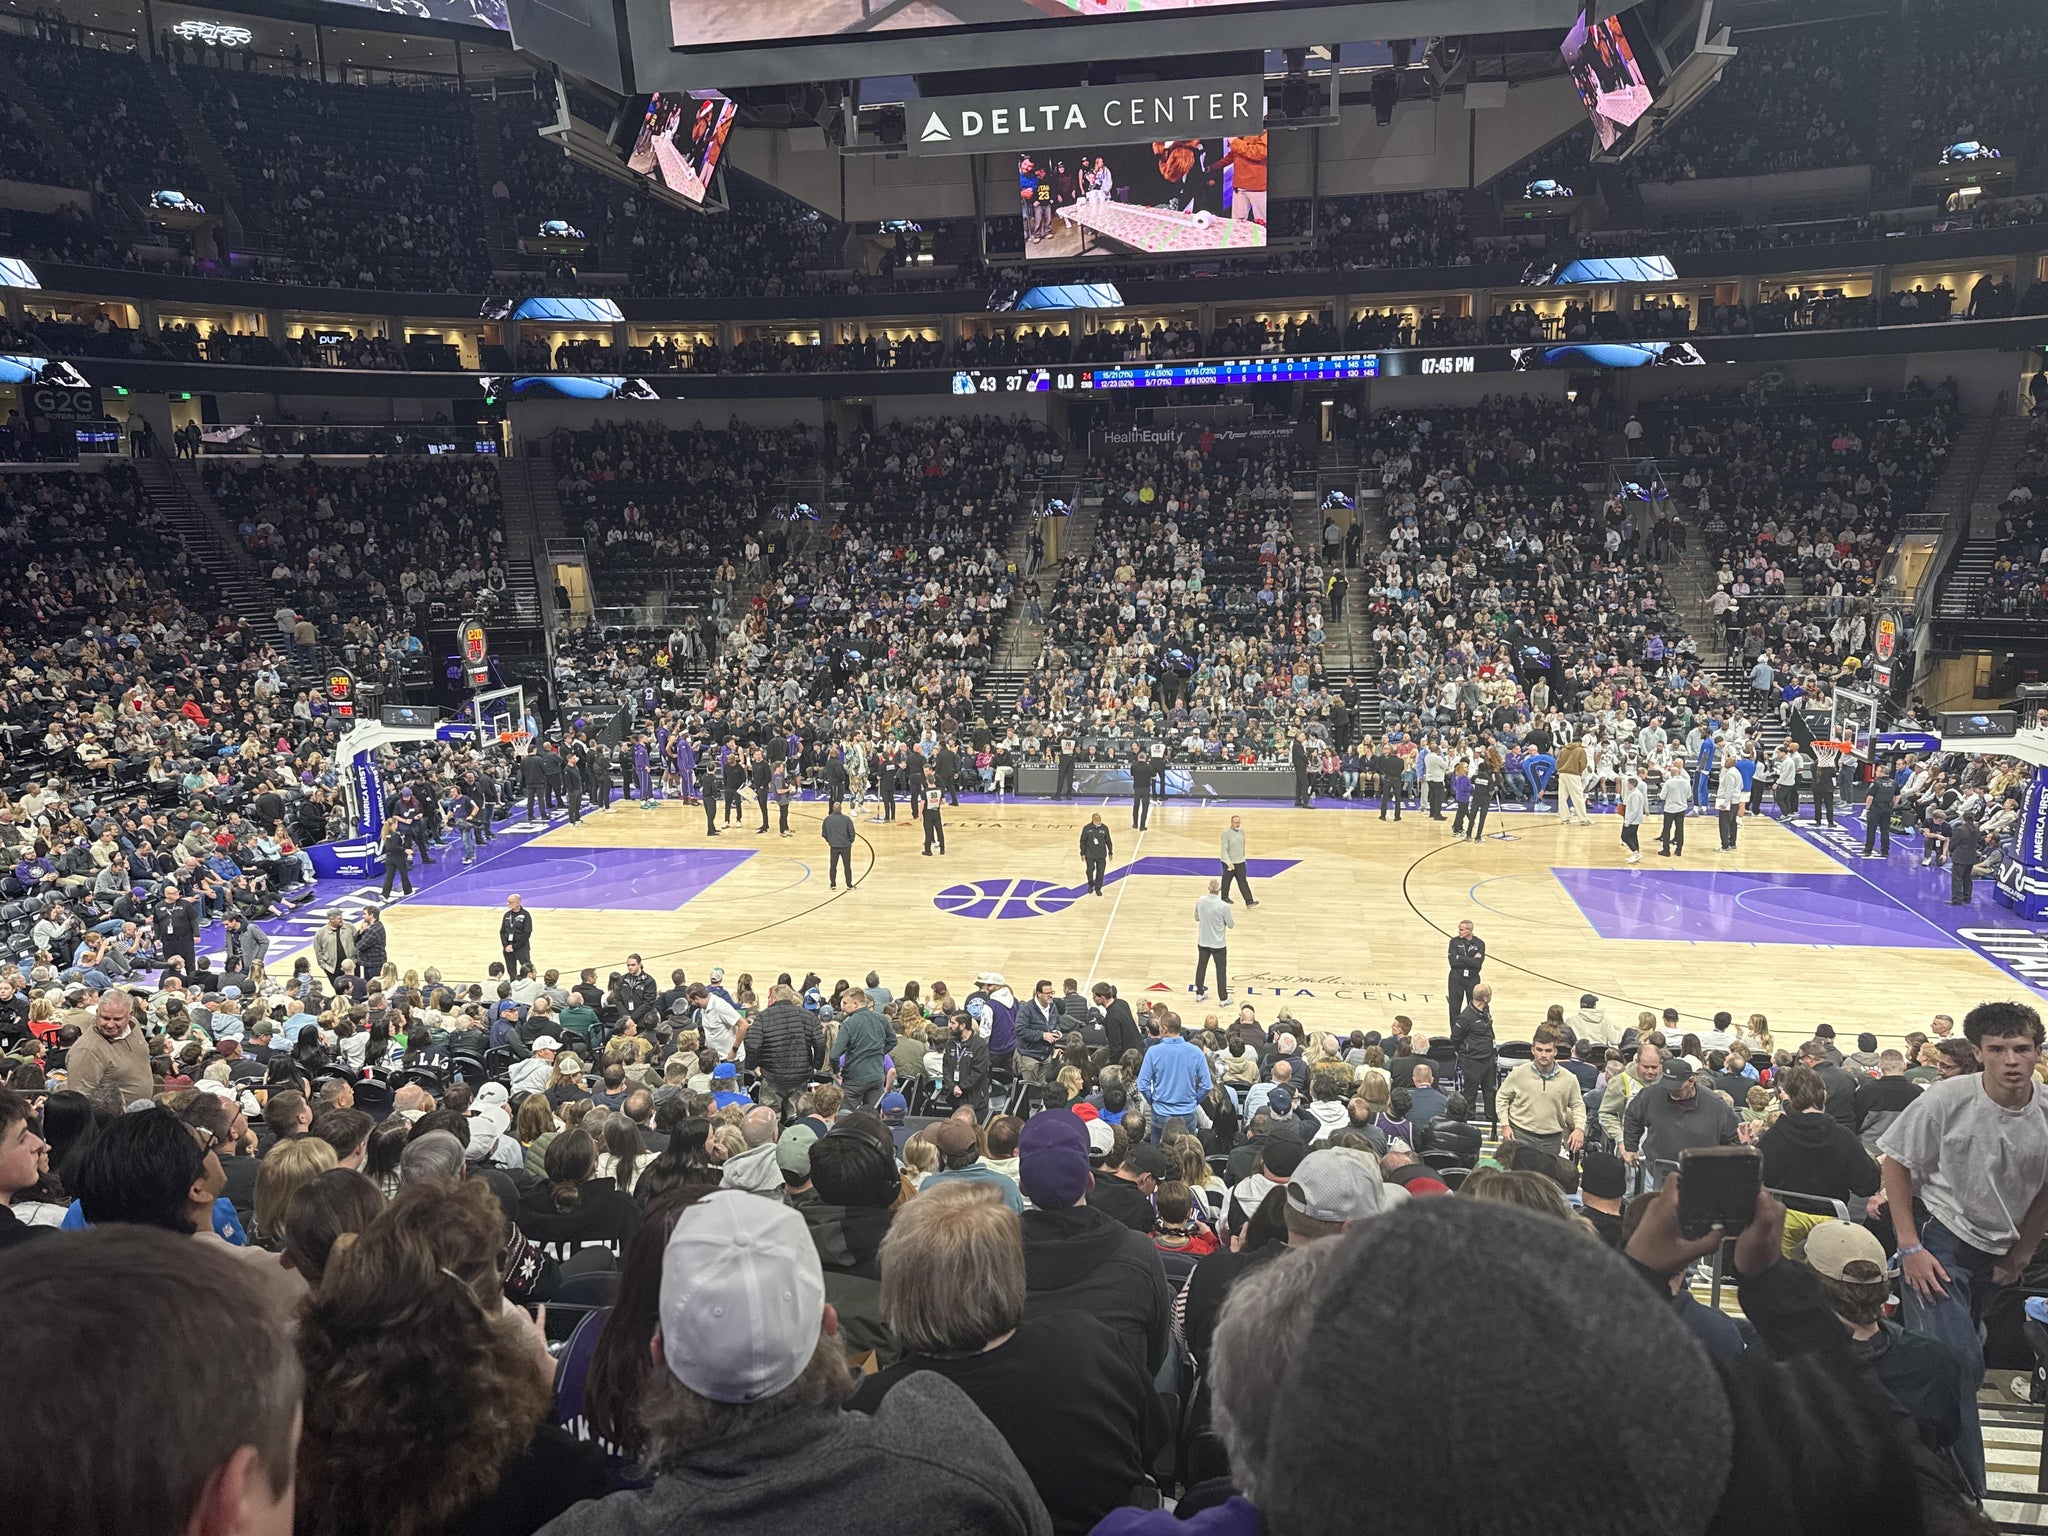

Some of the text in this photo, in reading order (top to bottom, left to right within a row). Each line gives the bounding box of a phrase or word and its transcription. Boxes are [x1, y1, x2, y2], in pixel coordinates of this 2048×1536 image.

[961, 91, 1249, 137] DELTA CENTER
[1038, 191, 1050, 200] 23
[319, 335, 344, 345] pur
[1422, 356, 1474, 374] 07:45 PM
[980, 376, 996, 392] 43
[1006, 376, 1022, 391] 37
[1058, 374, 1074, 389] 0.0
[1080, 380, 1092, 388] 2ND
[1082, 372, 1091, 380] 24
[34, 390, 93, 412] G2G
[1104, 430, 1183, 444] HealthEquity
[468, 640, 483, 660] 24
[1878, 633, 1892, 656] 24
[332, 685, 347, 696] 24
[646, 692, 654, 700] 23
[358, 766, 372, 827] AMERICA FIRST
[370, 766, 386, 824] AMERICA FIRST
[2015, 783, 2036, 856] AMERICA FIRST
[2034, 786, 2048, 861] AMERICA FIRST
[1997, 882, 2014, 896] AMERICA
[2012, 890, 2026, 902] FIRST
